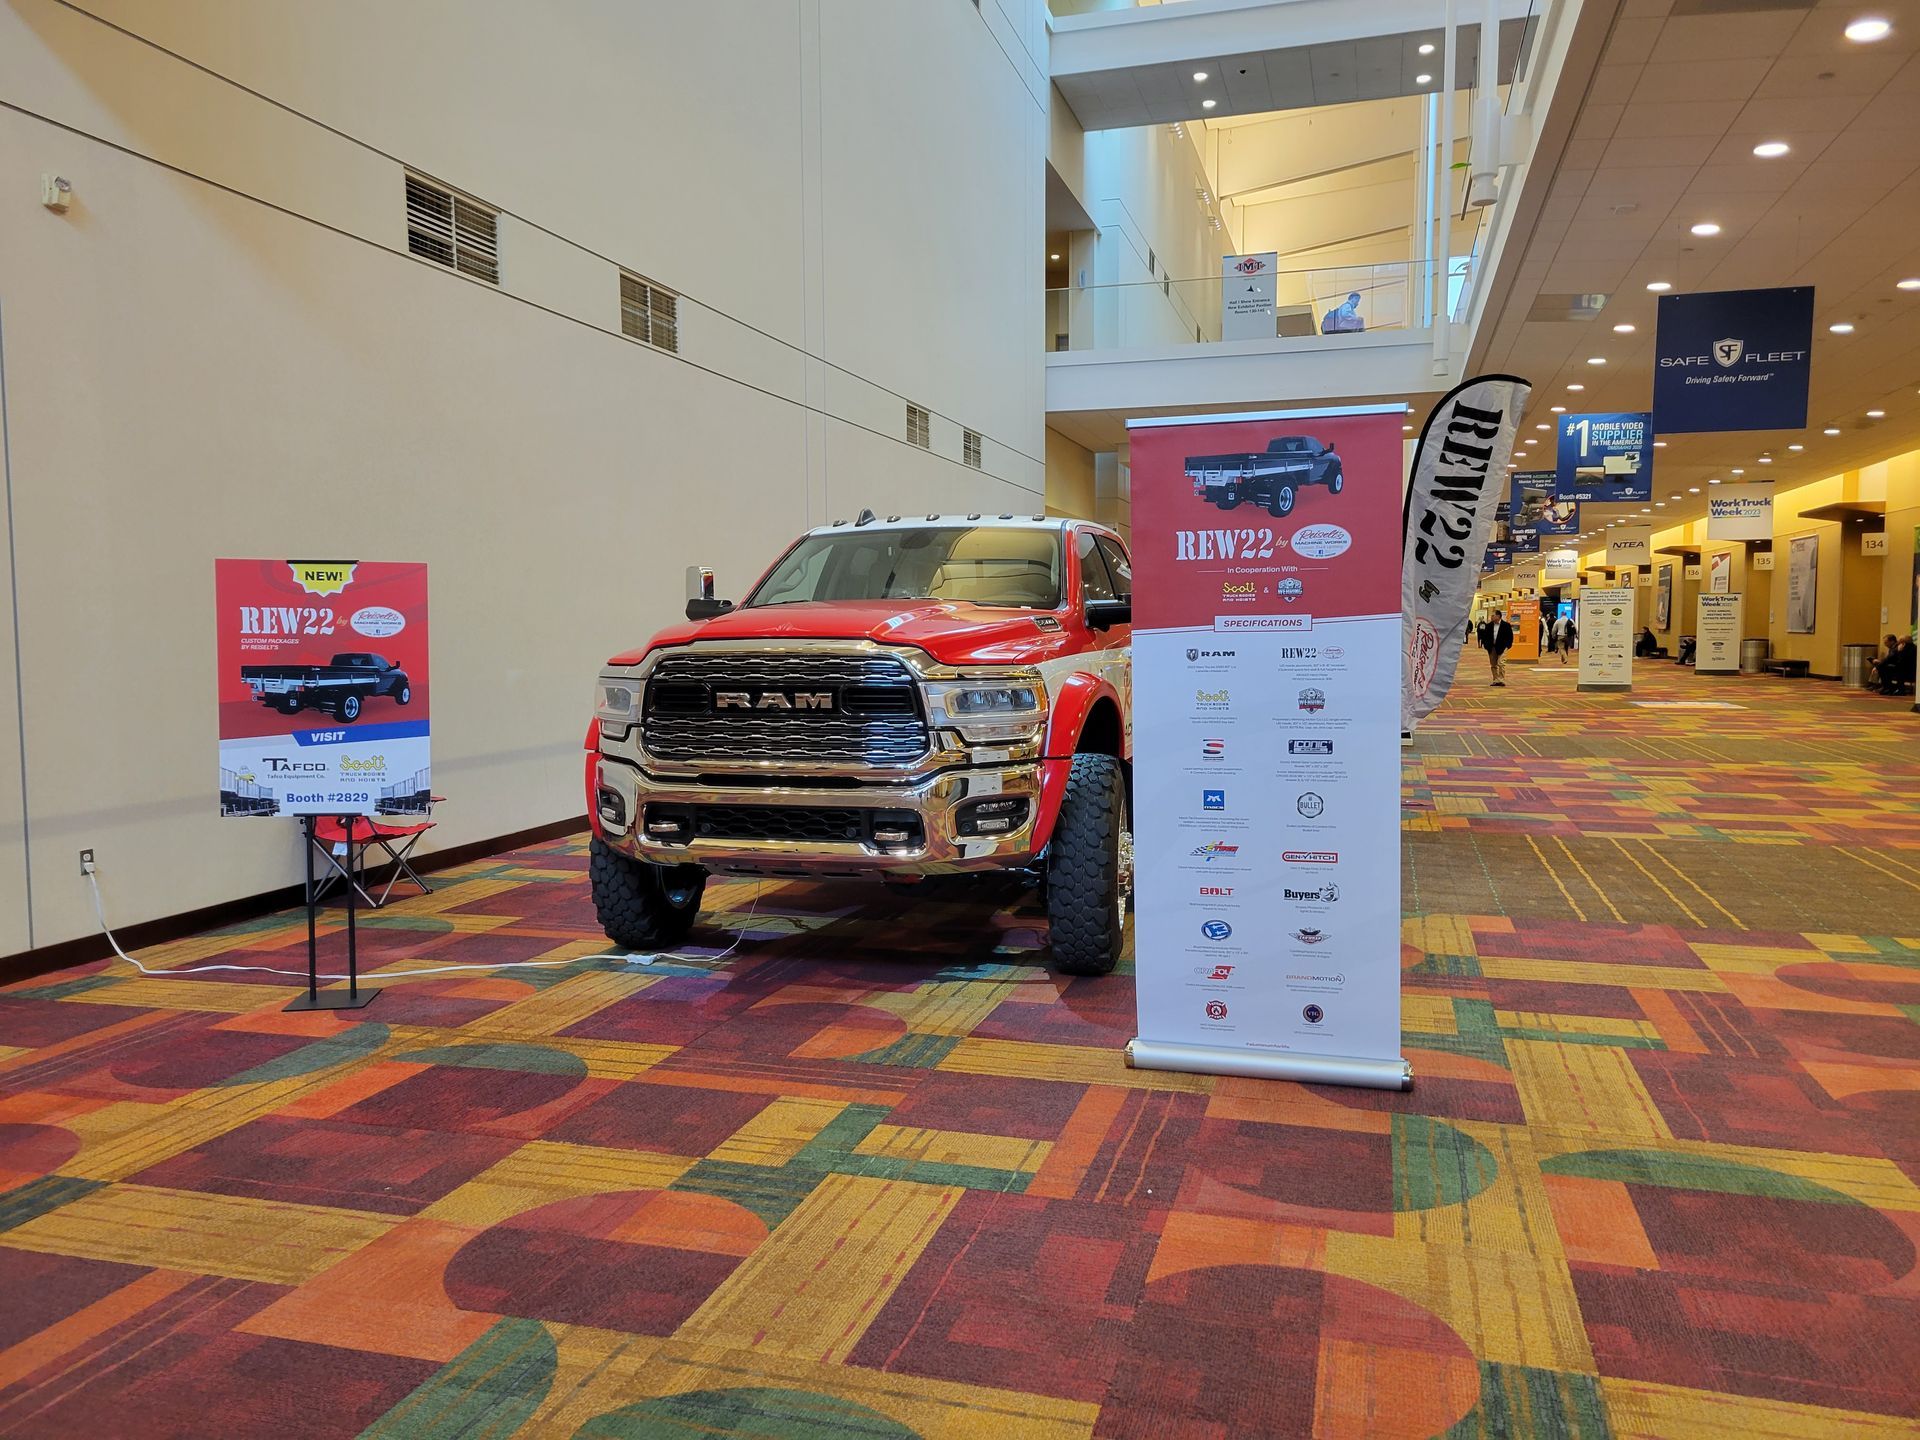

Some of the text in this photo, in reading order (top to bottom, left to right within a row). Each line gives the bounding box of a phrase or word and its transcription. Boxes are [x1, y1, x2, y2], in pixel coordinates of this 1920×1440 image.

[1660, 355, 1710, 367] SAFE
[1745, 350, 1806, 363] FLEET
[1685, 375, 1712, 385] Driving
[1712, 374, 1737, 383] Safety
[1592, 422, 1644, 431] MOBILE VIDEO
[1592, 429, 1643, 441] SUPPLIER
[1415, 400, 1503, 569] REW22
[1711, 497, 1772, 508] Work Truck
[1711, 507, 1761, 516] Week 2023
[1299, 529, 1345, 541] Reiselt's
[1175, 528, 1274, 561] REW22
[1275, 536, 1289, 548] by
[1612, 541, 1645, 549] NTEA
[1865, 540, 1884, 549] 134
[1235, 566, 1281, 575] Cooperation
[304, 571, 344, 582] NEW!
[1222, 582, 1256, 593] Scott
[1263, 586, 1269, 594] &
[240, 605, 335, 635] REW22
[336, 615, 348, 627] by
[1223, 618, 1303, 628] SPECIFICATIONS
[1281, 647, 1317, 659] REW22
[716, 692, 833, 710] RAM
[311, 731, 346, 743] VISIT
[340, 755, 386, 771] Scott
[286, 793, 369, 803] Booth #2829
[1299, 801, 1321, 809] BULLET
[1200, 887, 1234, 896] BOLT
[1286, 973, 1342, 983] BRANDMOTION
